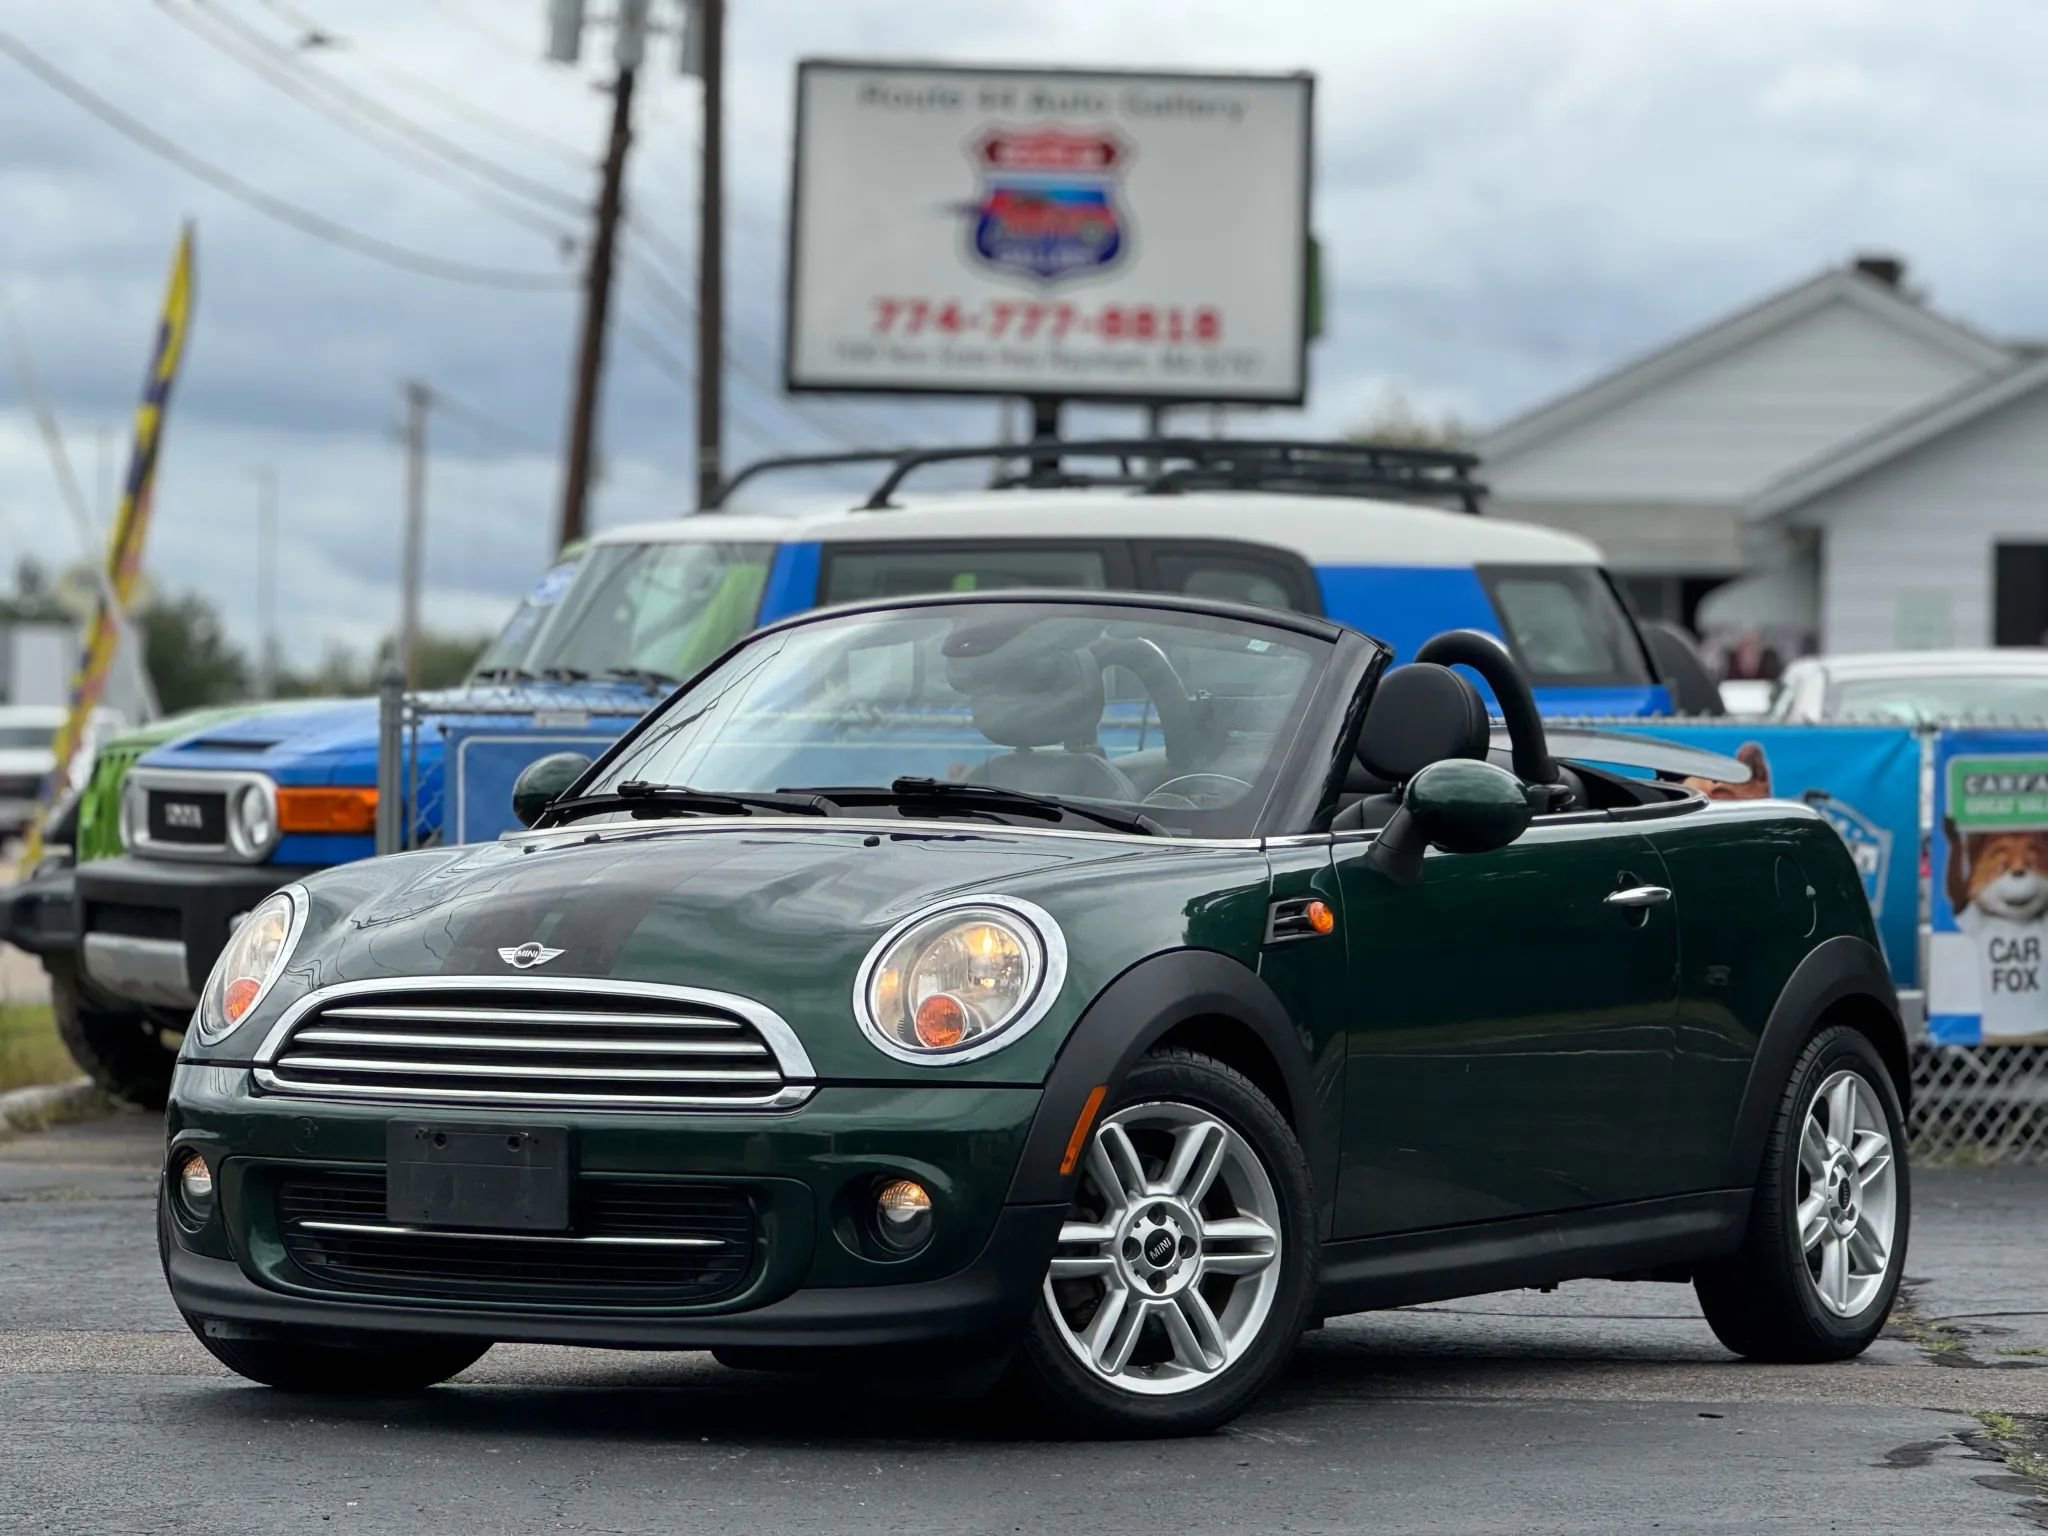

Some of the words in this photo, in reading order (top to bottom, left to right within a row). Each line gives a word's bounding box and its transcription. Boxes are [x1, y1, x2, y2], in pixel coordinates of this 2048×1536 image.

[860, 83, 959, 109] Route
[1027, 87, 1106, 112] Auto
[1122, 88, 1246, 122] Gallery
[517, 949, 538, 957] MINI
[1989, 937, 2041, 963] CAR
[1992, 968, 2040, 992] FOX
[1149, 1237, 1172, 1260] MINI
